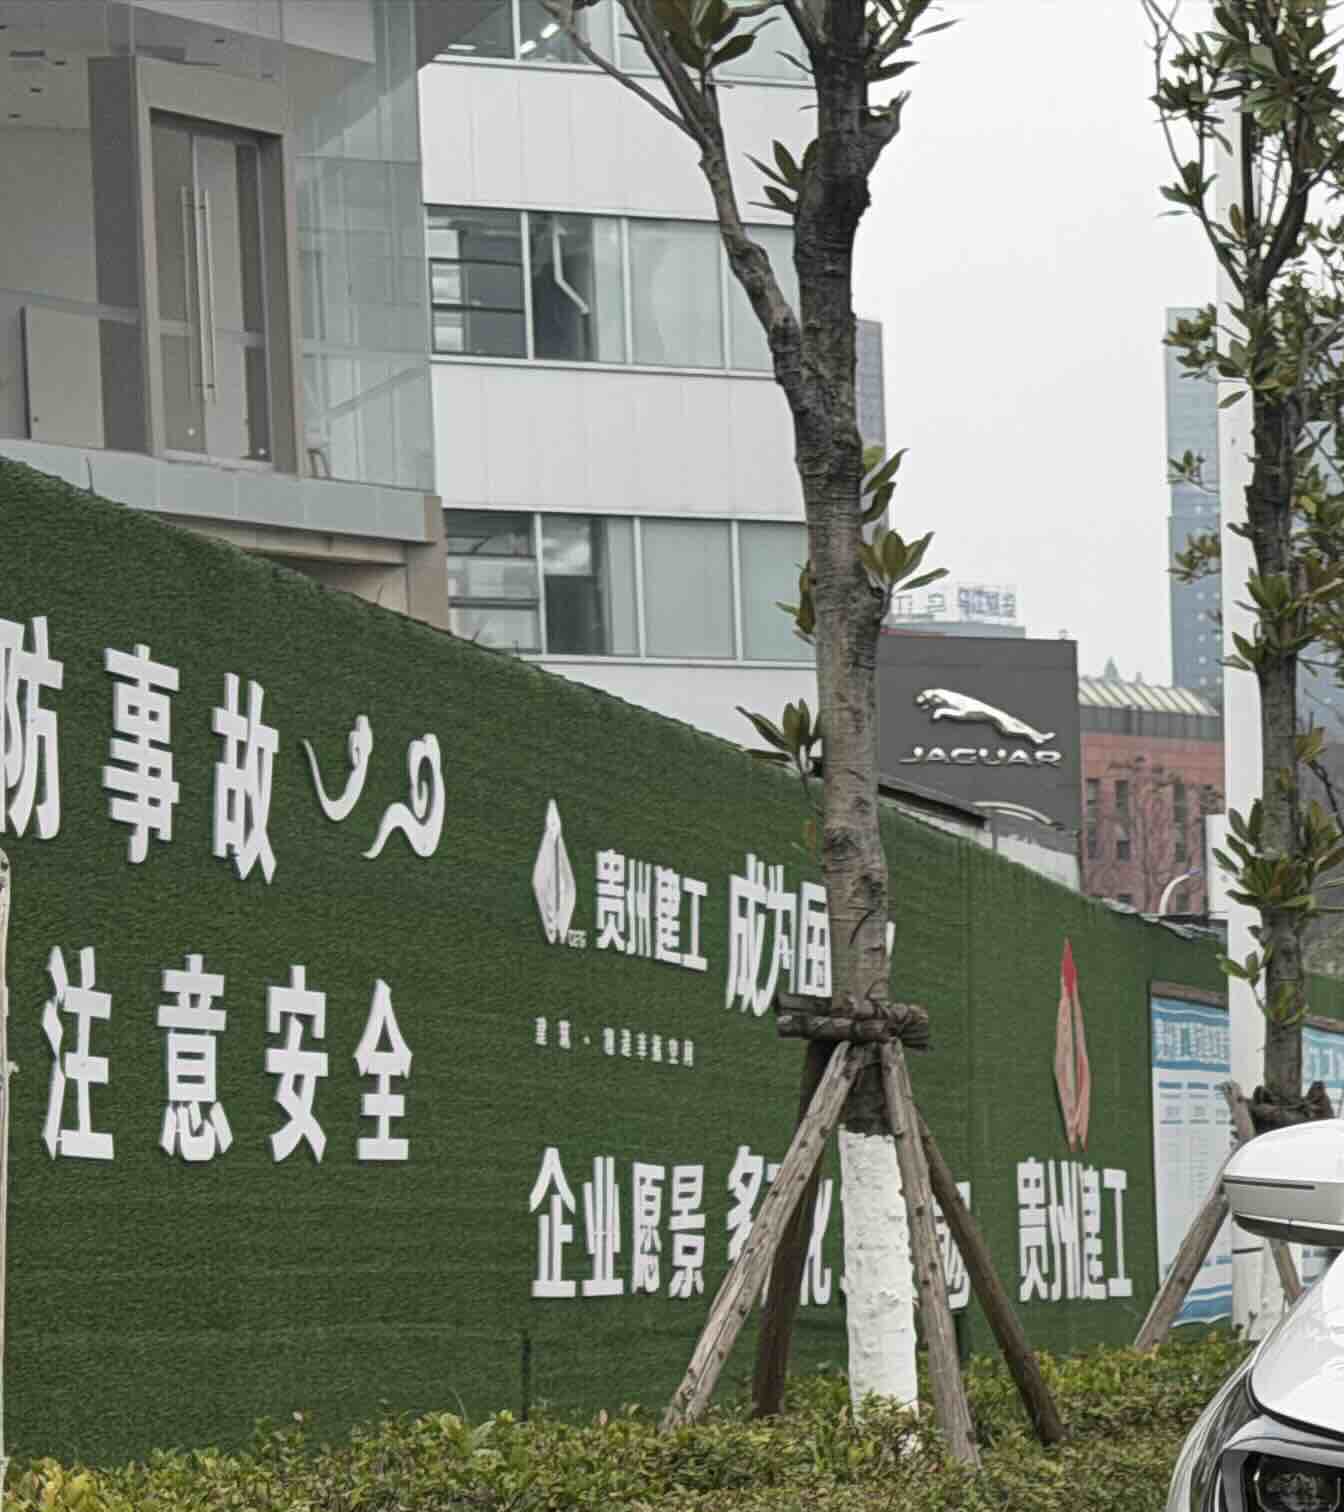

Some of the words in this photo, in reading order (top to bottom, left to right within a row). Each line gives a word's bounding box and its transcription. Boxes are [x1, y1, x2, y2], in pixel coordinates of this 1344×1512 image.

[0, 615, 280, 885] 防事故
[897, 745, 1063, 767] JAGUAR
[595, 848, 708, 972] 贵州建工
[41, 945, 414, 1164] 注意安全
[529, 1146, 706, 1299] 企业愿景
[1017, 1156, 1133, 1302] 贵州建工
